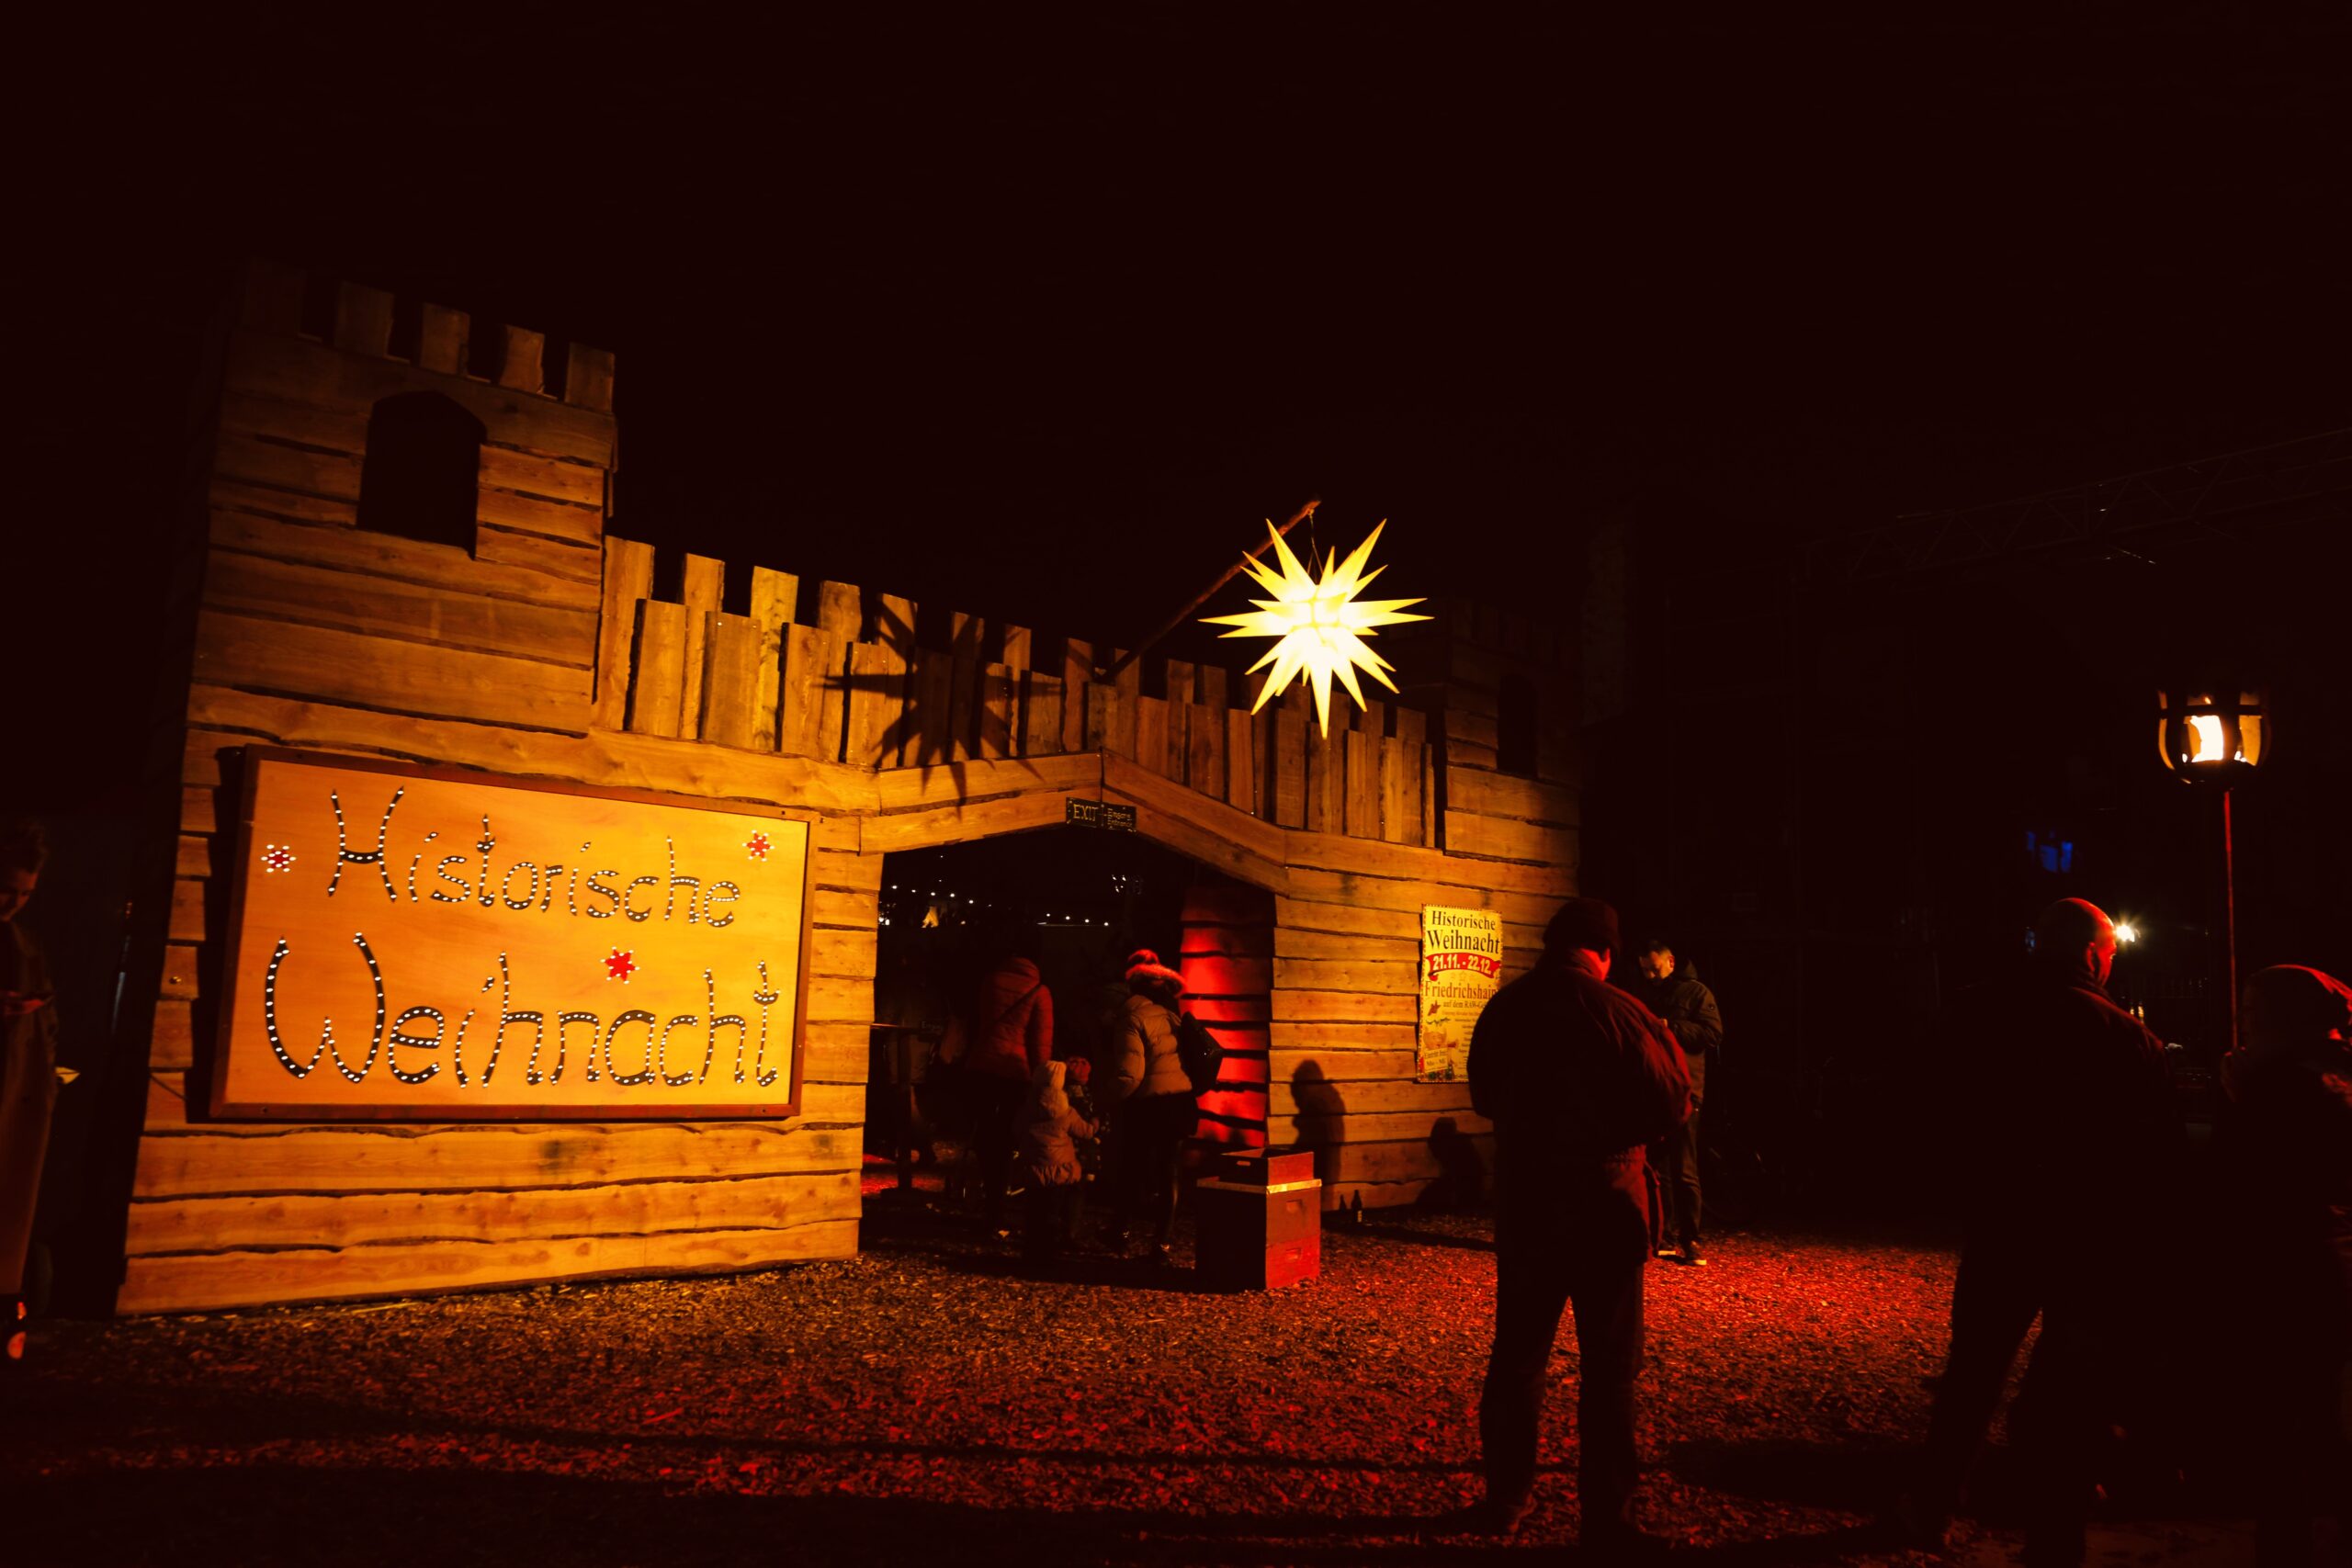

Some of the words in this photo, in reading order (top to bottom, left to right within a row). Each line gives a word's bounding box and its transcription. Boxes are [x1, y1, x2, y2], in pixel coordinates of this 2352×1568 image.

[1073, 803, 1099, 821] EXIT
[328, 785, 741, 928] Historische
[1431, 910, 1496, 930] Historische
[1427, 929, 1500, 953] Weihnacht
[1432, 953, 1461, 971] 21.11.
[1467, 954, 1492, 975] 22.12.
[265, 931, 781, 1088] Weihnacht
